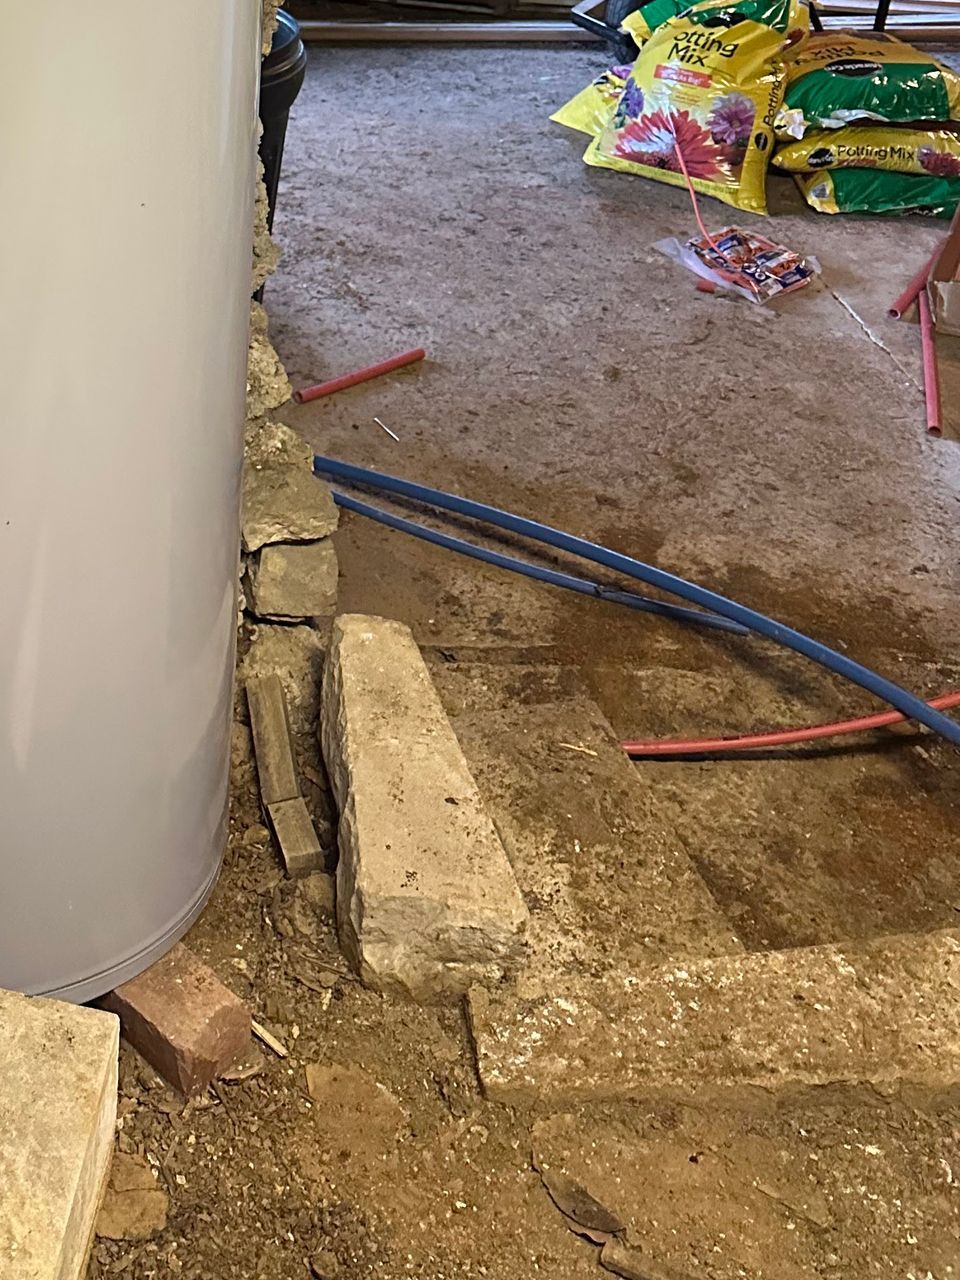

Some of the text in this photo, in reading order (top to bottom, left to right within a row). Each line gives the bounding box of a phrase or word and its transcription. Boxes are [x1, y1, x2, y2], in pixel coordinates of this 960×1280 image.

[667, 42, 709, 67] Mix
[762, 80, 783, 127] Potting
[837, 144, 888, 160] Potting
[889, 146, 915, 160] Mix
